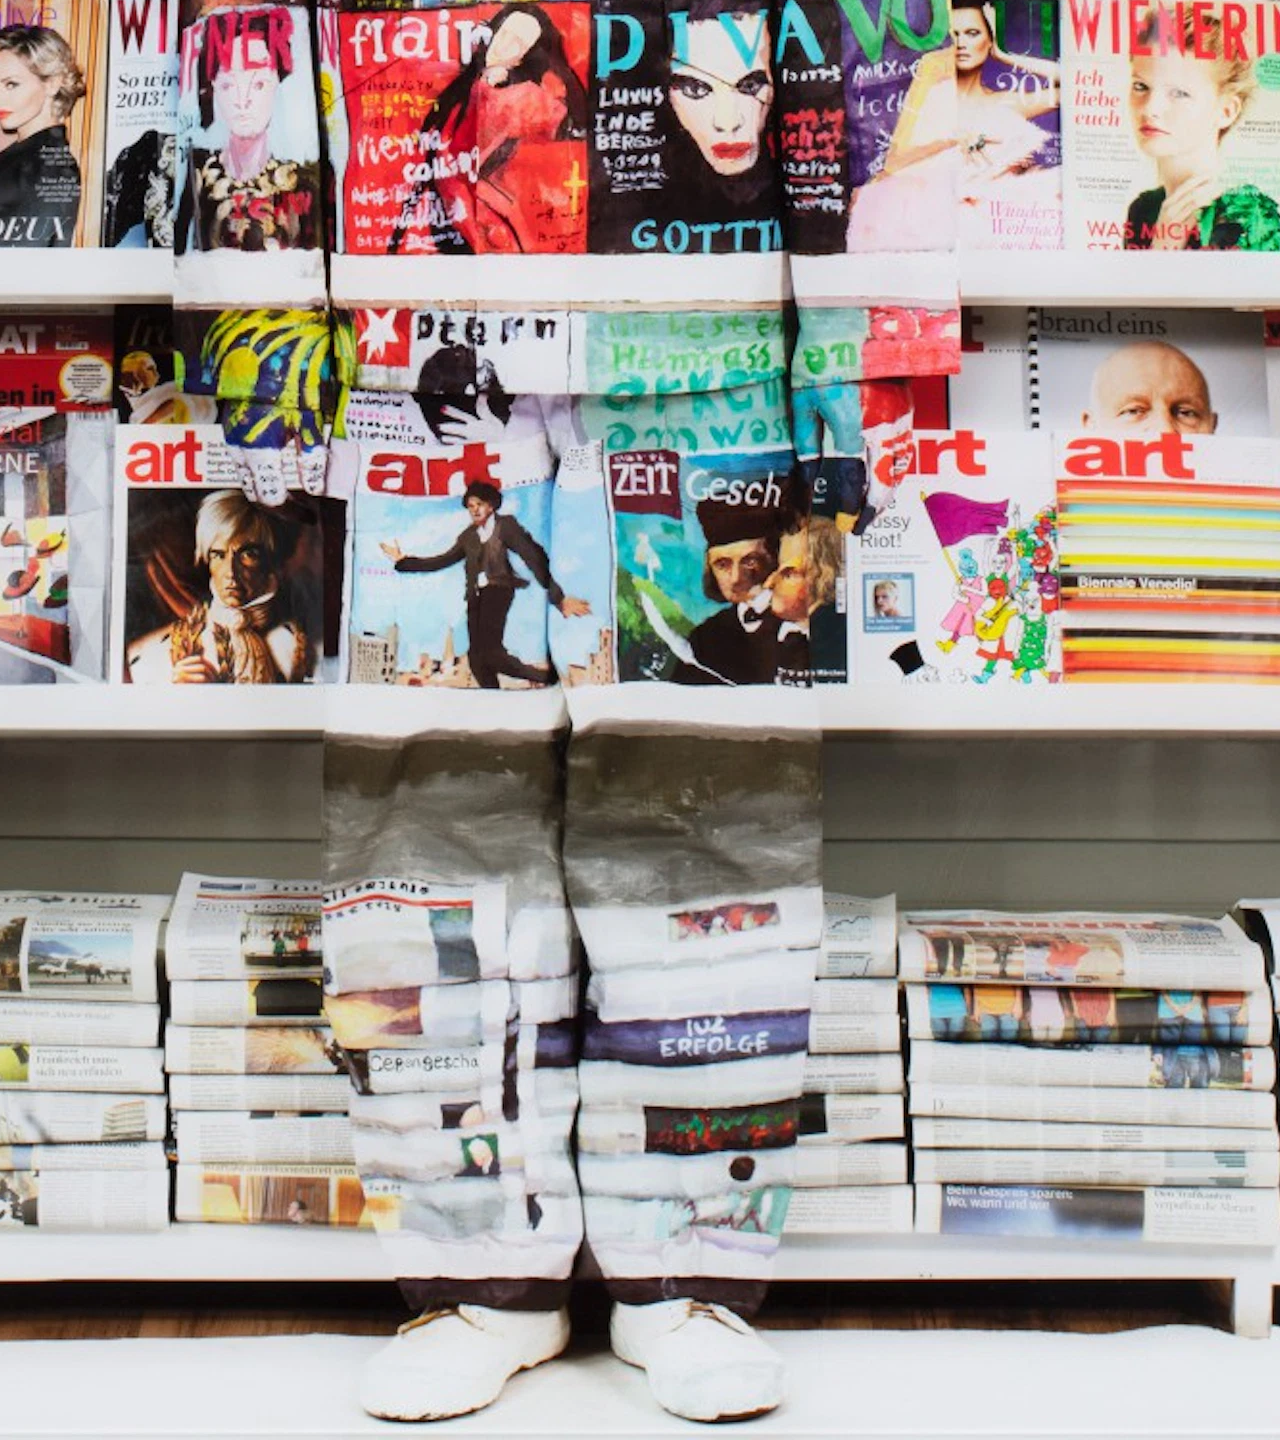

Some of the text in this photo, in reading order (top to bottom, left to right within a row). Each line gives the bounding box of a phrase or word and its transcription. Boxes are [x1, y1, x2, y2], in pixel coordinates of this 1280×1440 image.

[117, 91, 166, 109] 2013!
[1040, 314, 1166, 335] brand eins
[126, 431, 203, 483] art
[1064, 433, 1196, 479] art
[367, 444, 502, 496] art
[614, 465, 679, 497] ZEIT
[861, 532, 903, 549] Riot!
[1079, 577, 1197, 591] Biennale Venedig!
[659, 1031, 771, 1056] ERFOLGE
